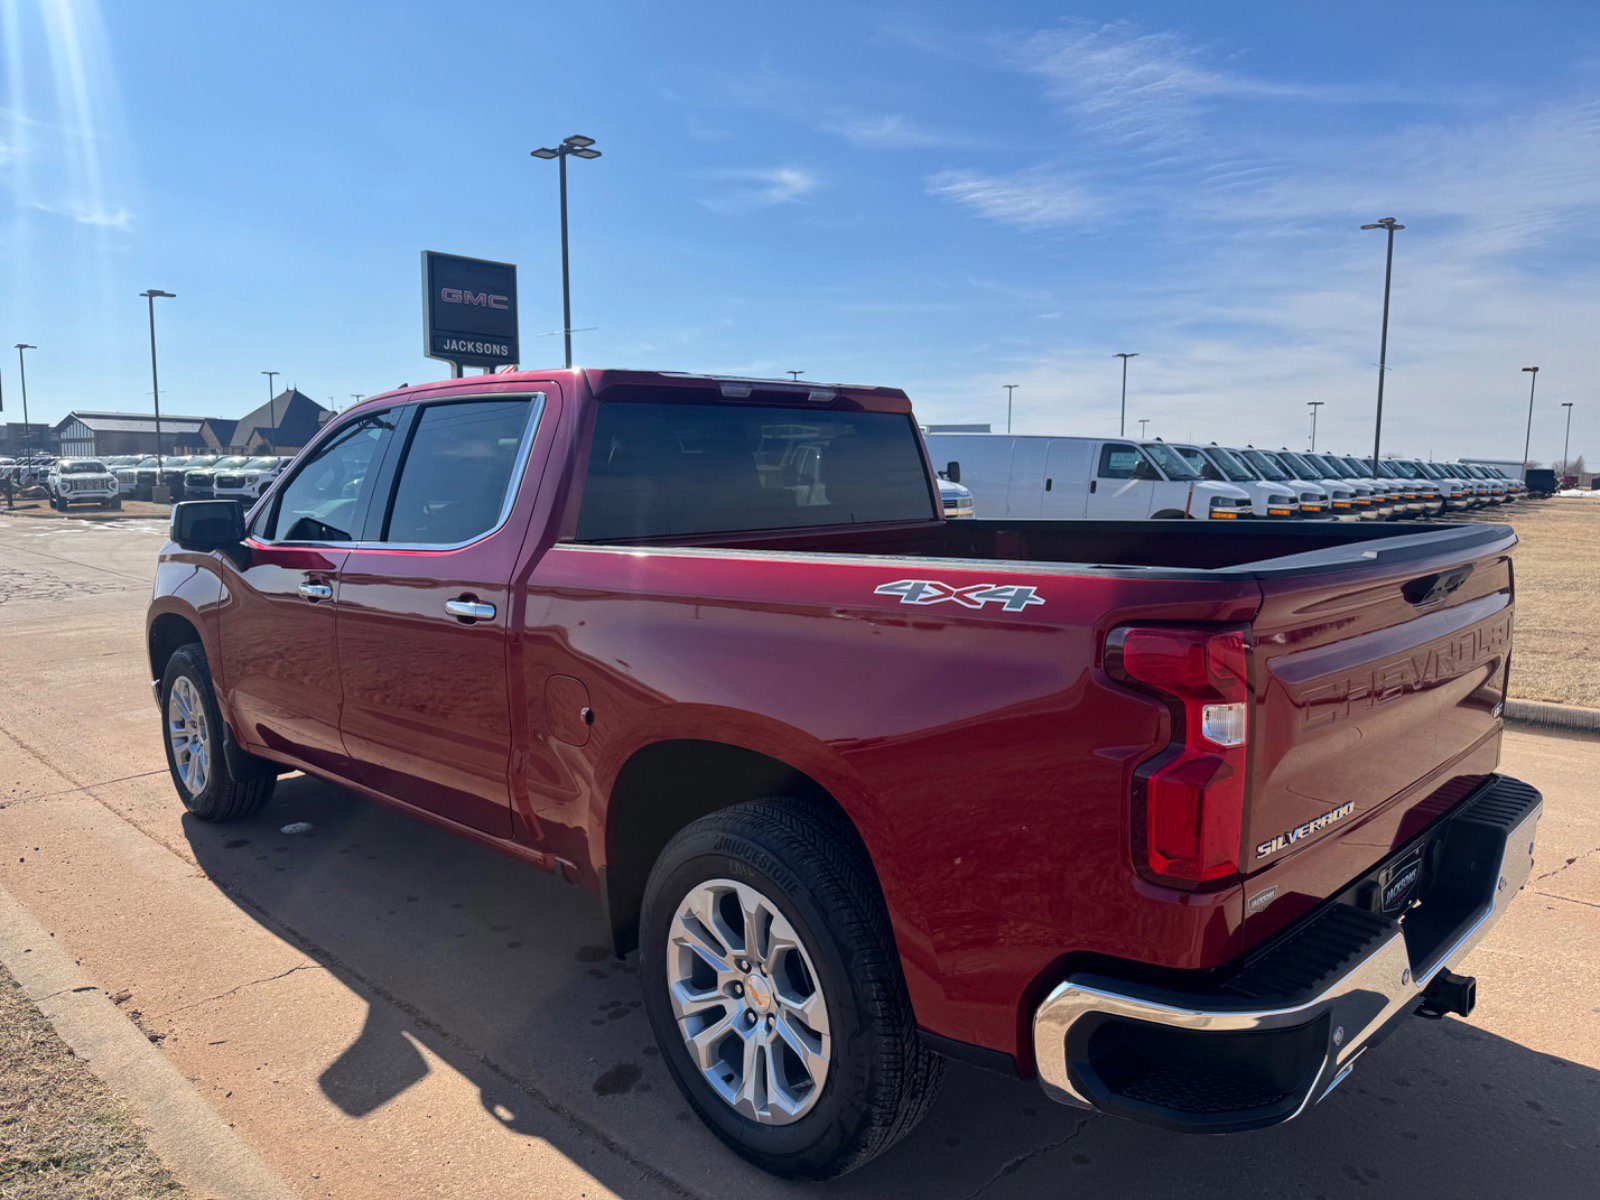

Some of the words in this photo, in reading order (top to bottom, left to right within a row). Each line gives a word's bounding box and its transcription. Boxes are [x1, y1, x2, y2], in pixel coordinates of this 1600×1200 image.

[441, 287, 510, 310] GMC
[443, 339, 508, 355] JACKSONS
[1256, 801, 1355, 860] SILVERADO
[713, 834, 799, 897] BRIDGESTONE
